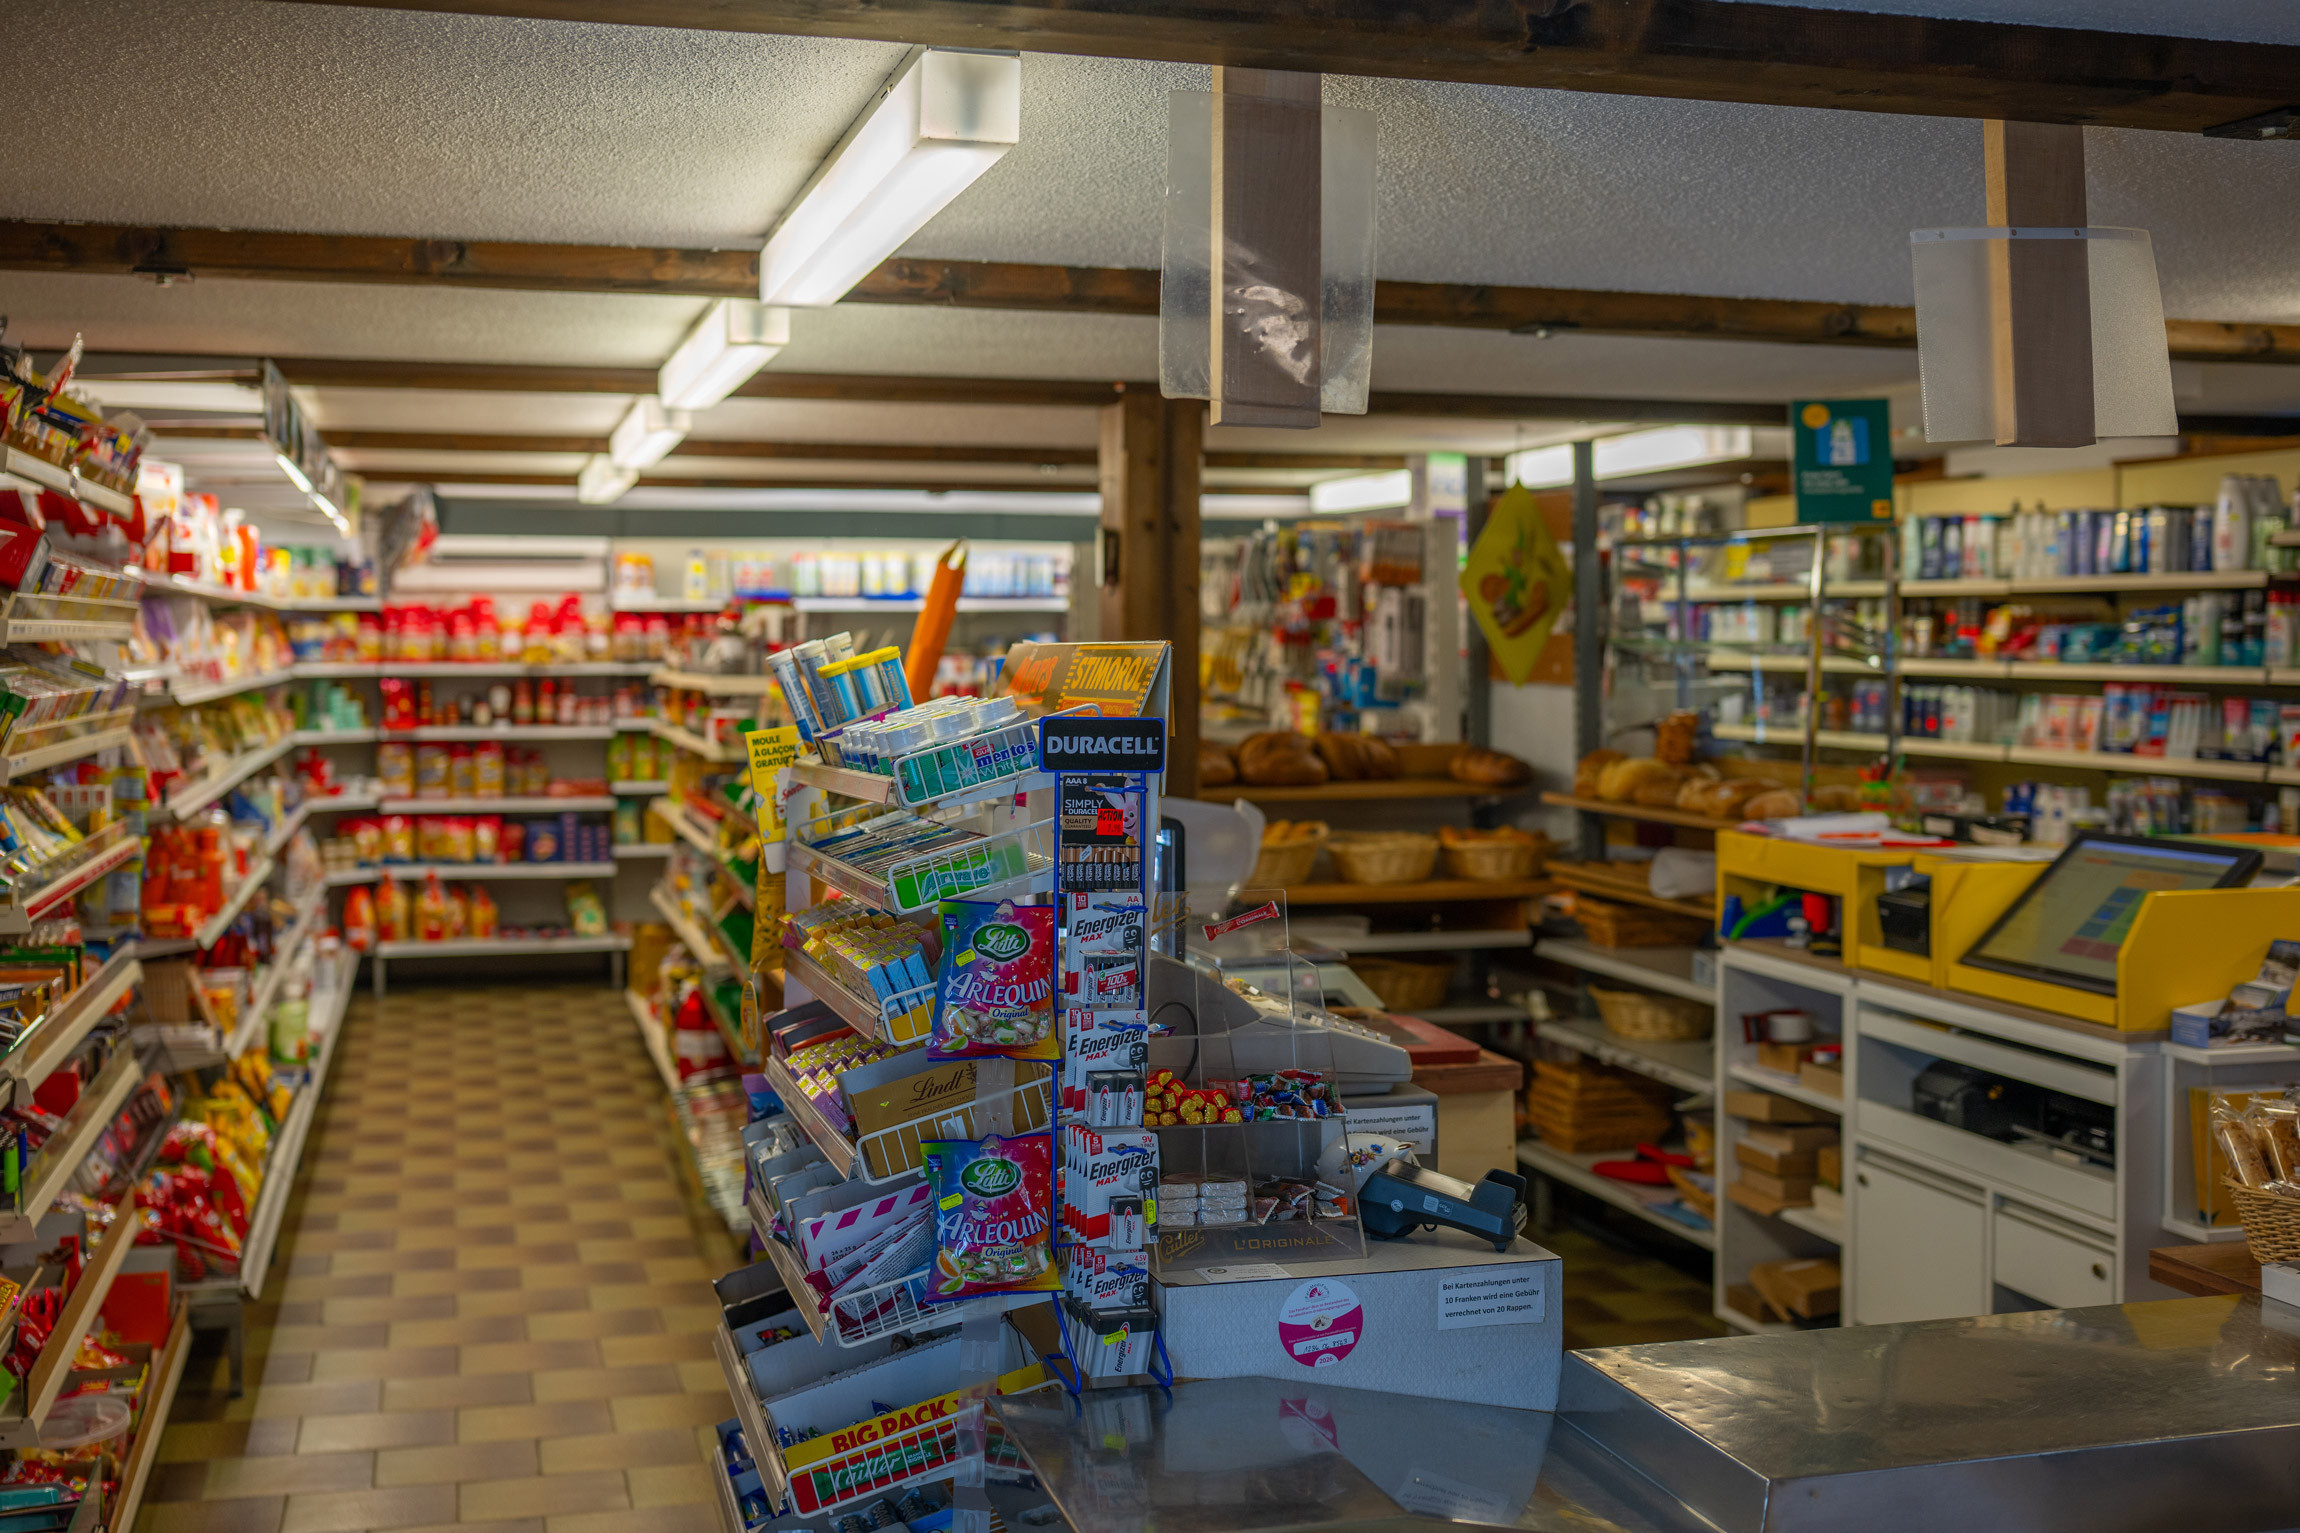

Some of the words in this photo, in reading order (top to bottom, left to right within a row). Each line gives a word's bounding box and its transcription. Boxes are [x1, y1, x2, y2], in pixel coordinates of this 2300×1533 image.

[1071, 656, 1148, 692] STIMOROL
[752, 735, 781, 746] MOULE
[1047, 736, 1159, 755] DURACELL
[761, 745, 800, 756] GLAÇON
[975, 741, 1036, 768] mentos
[1065, 799, 1104, 809] SIMPLY
[1097, 810, 1123, 821] ACTION
[1074, 912, 1140, 937] Energizer
[978, 927, 1021, 953] Lutti
[1081, 932, 1103, 943] MAX
[944, 972, 1051, 1009] ARLEQUIN
[992, 1008, 1028, 1020] Original
[1079, 1030, 1143, 1056] Energizer
[1085, 1050, 1108, 1062] MAX
[909, 1068, 965, 1103] Lindt
[1353, 1116, 1403, 1125] Kartenzahlungen
[1089, 1150, 1156, 1181] Energizer
[967, 1163, 1012, 1188] Lutti
[1096, 1175, 1118, 1187] MAX
[937, 1206, 1049, 1247] ARLEQUIN
[1234, 1235, 1334, 1250] L'ORIGINALE
[985, 1245, 1023, 1258] Original
[1094, 1271, 1144, 1295] Energizer
[1455, 1278, 1511, 1289] Kartenzahlungen
[1099, 1289, 1117, 1300] MAX
[1455, 1295, 1482, 1303] Franken
[1515, 1289, 1540, 1297] Gebühr
[1445, 1308, 1481, 1318] verrechnet
[1507, 1304, 1533, 1312] Rappen.
[1115, 1340, 1128, 1373] Energizer
[1319, 1355, 1333, 1364] 2026
[831, 1424, 879, 1454] BIG
[880, 1399, 952, 1436] PACK
[834, 1451, 902, 1488] Cailler
